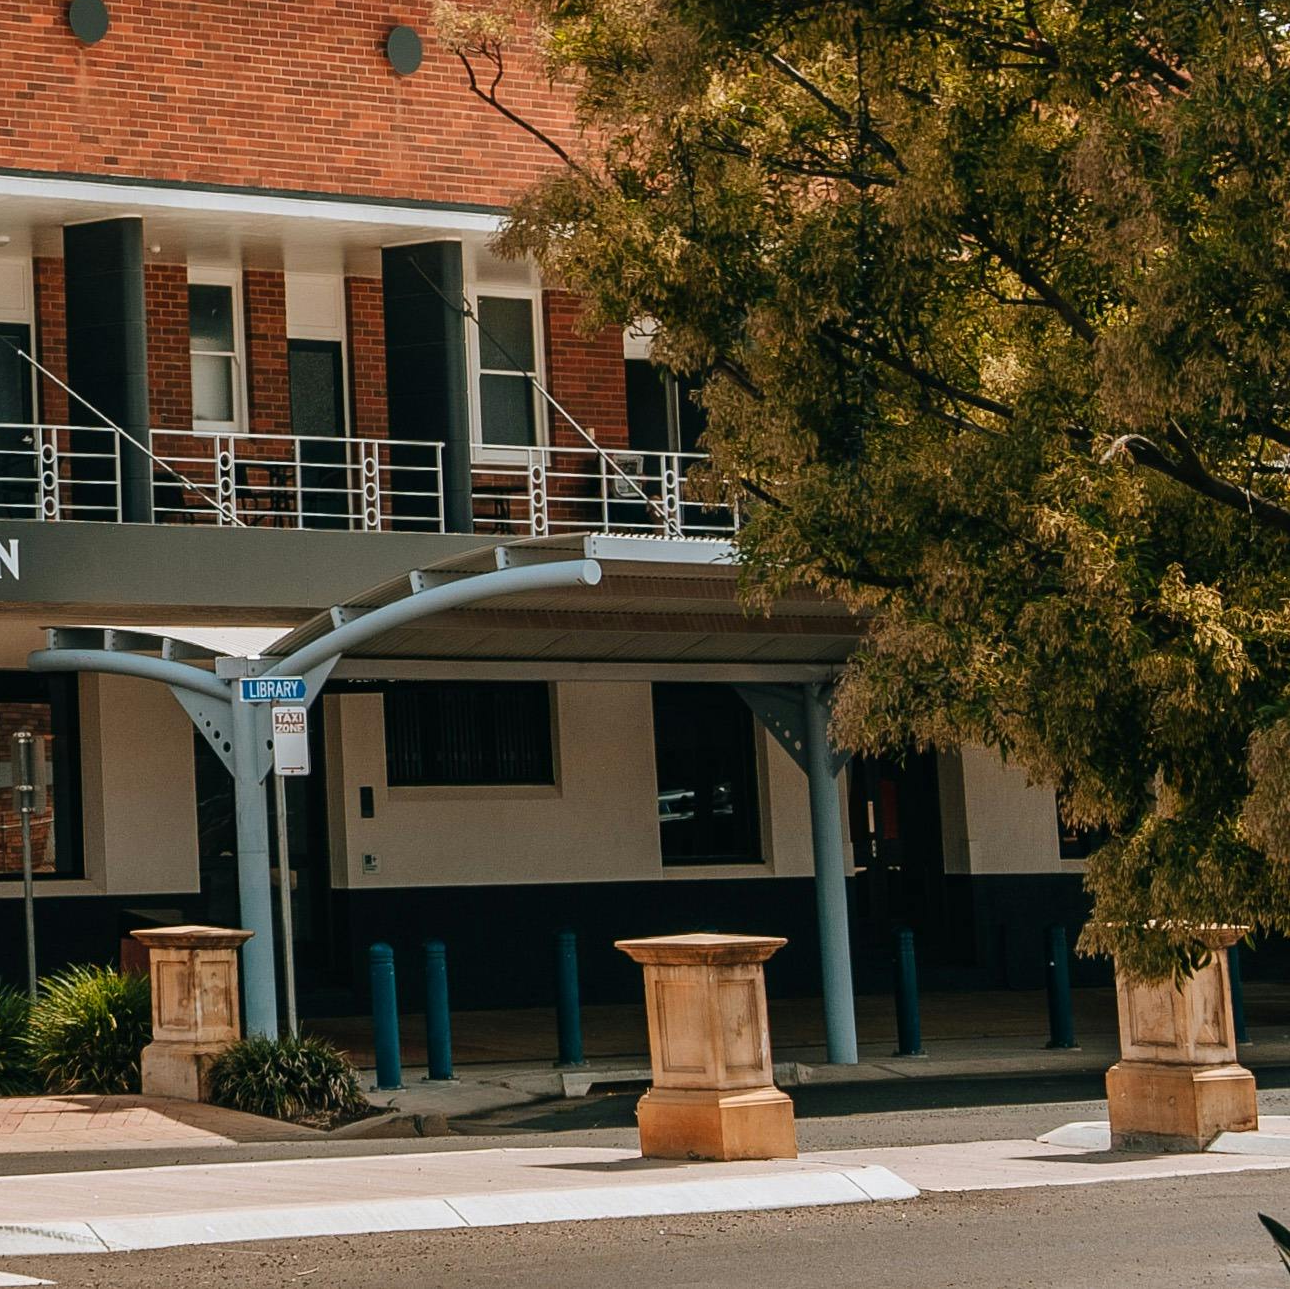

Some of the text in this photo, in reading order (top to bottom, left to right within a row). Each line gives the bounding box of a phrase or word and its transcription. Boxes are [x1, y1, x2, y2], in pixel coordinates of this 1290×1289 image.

[248, 680, 299, 698] LIBRARY
[276, 713, 303, 723] TAXI
[275, 723, 304, 733] ZONE
